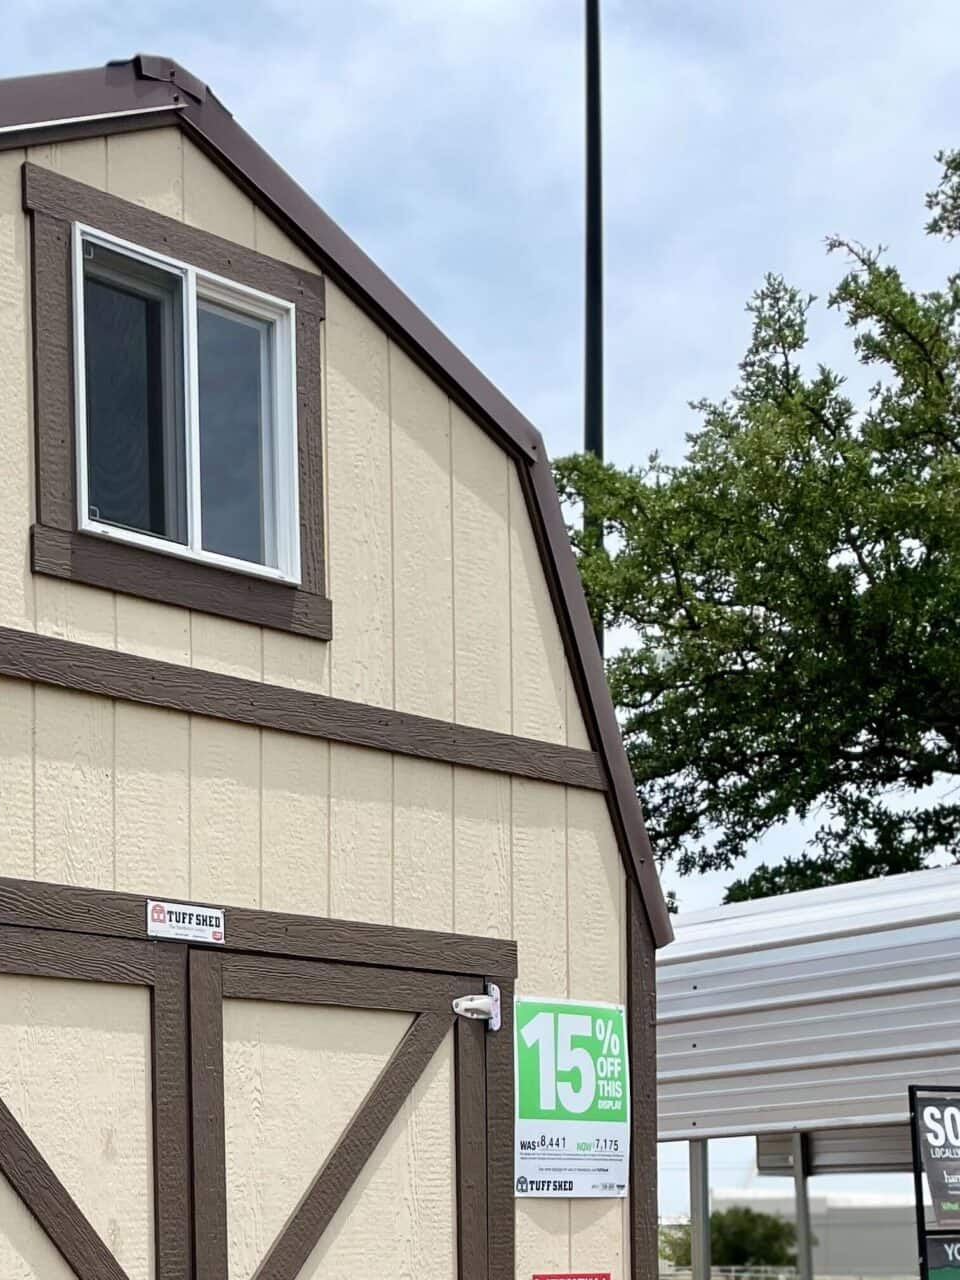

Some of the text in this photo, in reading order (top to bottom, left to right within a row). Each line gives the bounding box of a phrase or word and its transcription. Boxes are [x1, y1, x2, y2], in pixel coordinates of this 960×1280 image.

[167, 910, 195, 925] TUFF
[195, 913, 221, 928] SHED
[596, 1056, 622, 1078] OFF
[597, 1079, 623, 1099] THIS
[597, 1099, 623, 1111] DISPLAY
[520, 1140, 537, 1151] WAS
[576, 1141, 592, 1152] NOW
[528, 1179, 574, 1192] TUFF SHED
